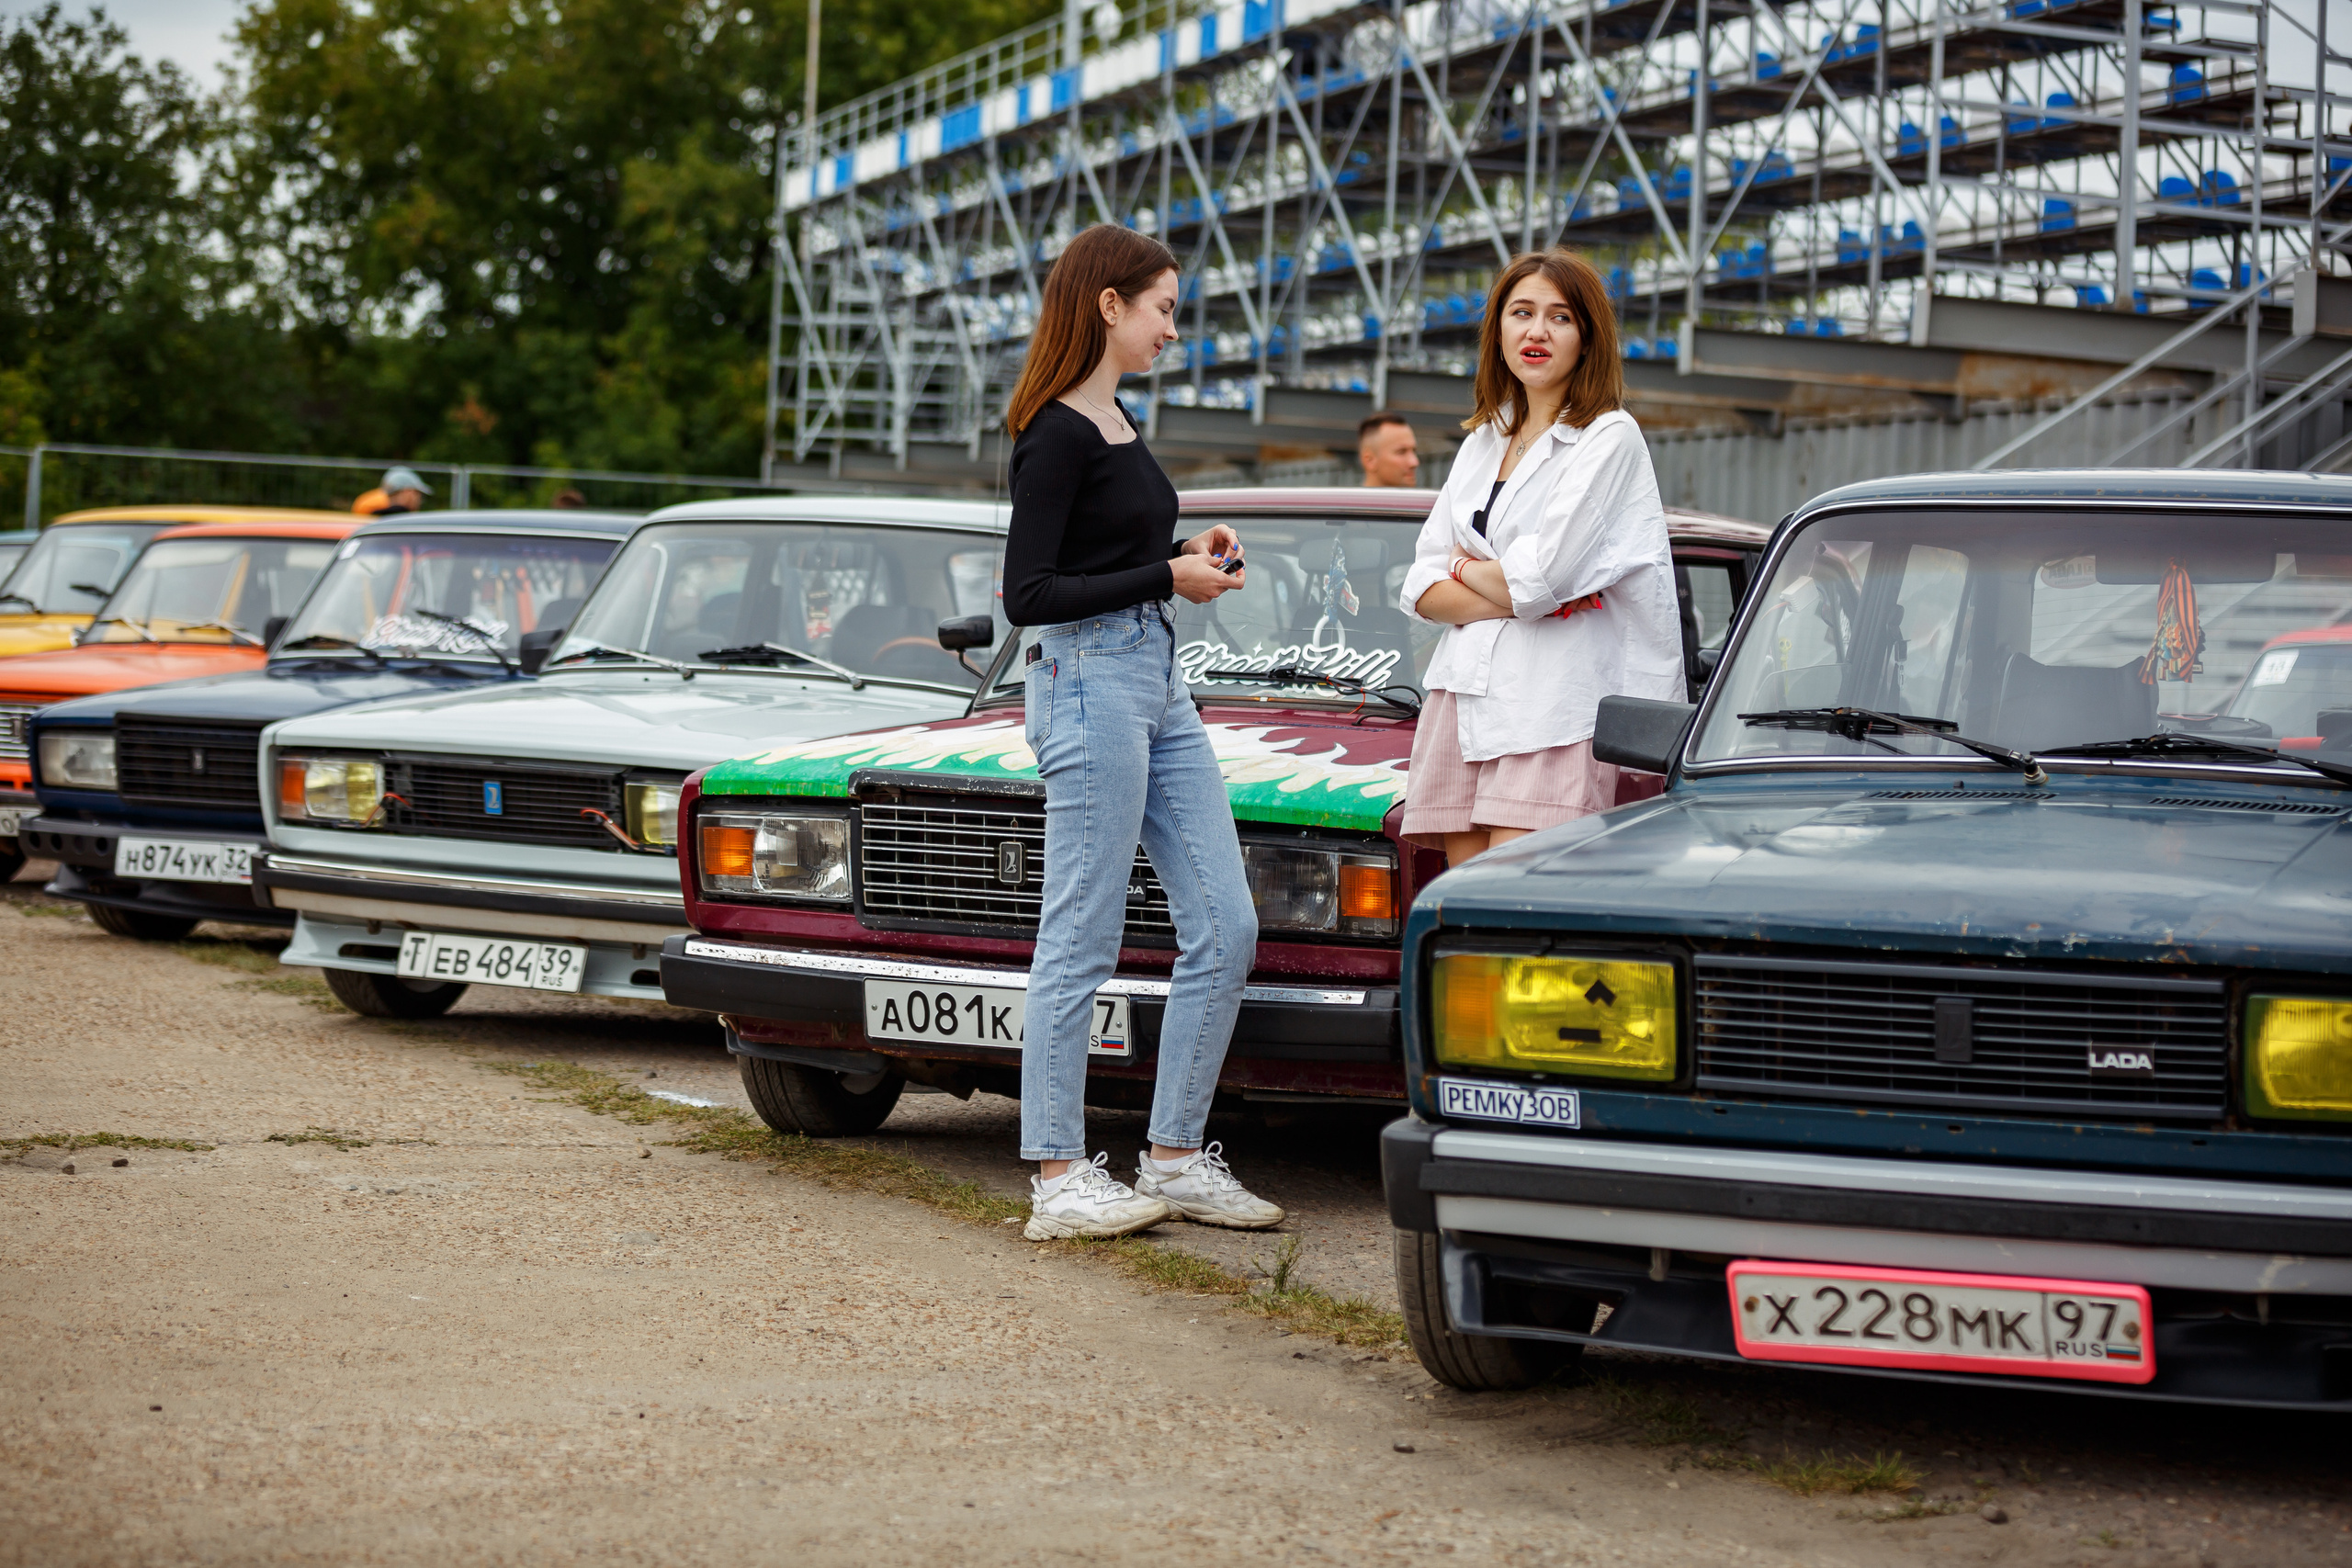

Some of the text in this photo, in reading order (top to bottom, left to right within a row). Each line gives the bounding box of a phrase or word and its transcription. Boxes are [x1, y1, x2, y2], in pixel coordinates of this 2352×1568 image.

[1126, 885, 1145, 895] DA
[540, 947, 573, 976] 39
[540, 976, 564, 987] RUS
[881, 989, 1024, 1042] А081К
[2088, 1052, 2153, 1070] LADA
[1448, 1087, 1572, 1121] РЕМКУЗОВ
[2053, 1300, 2119, 1341] 97
[2055, 1341, 2104, 1358] RUS
